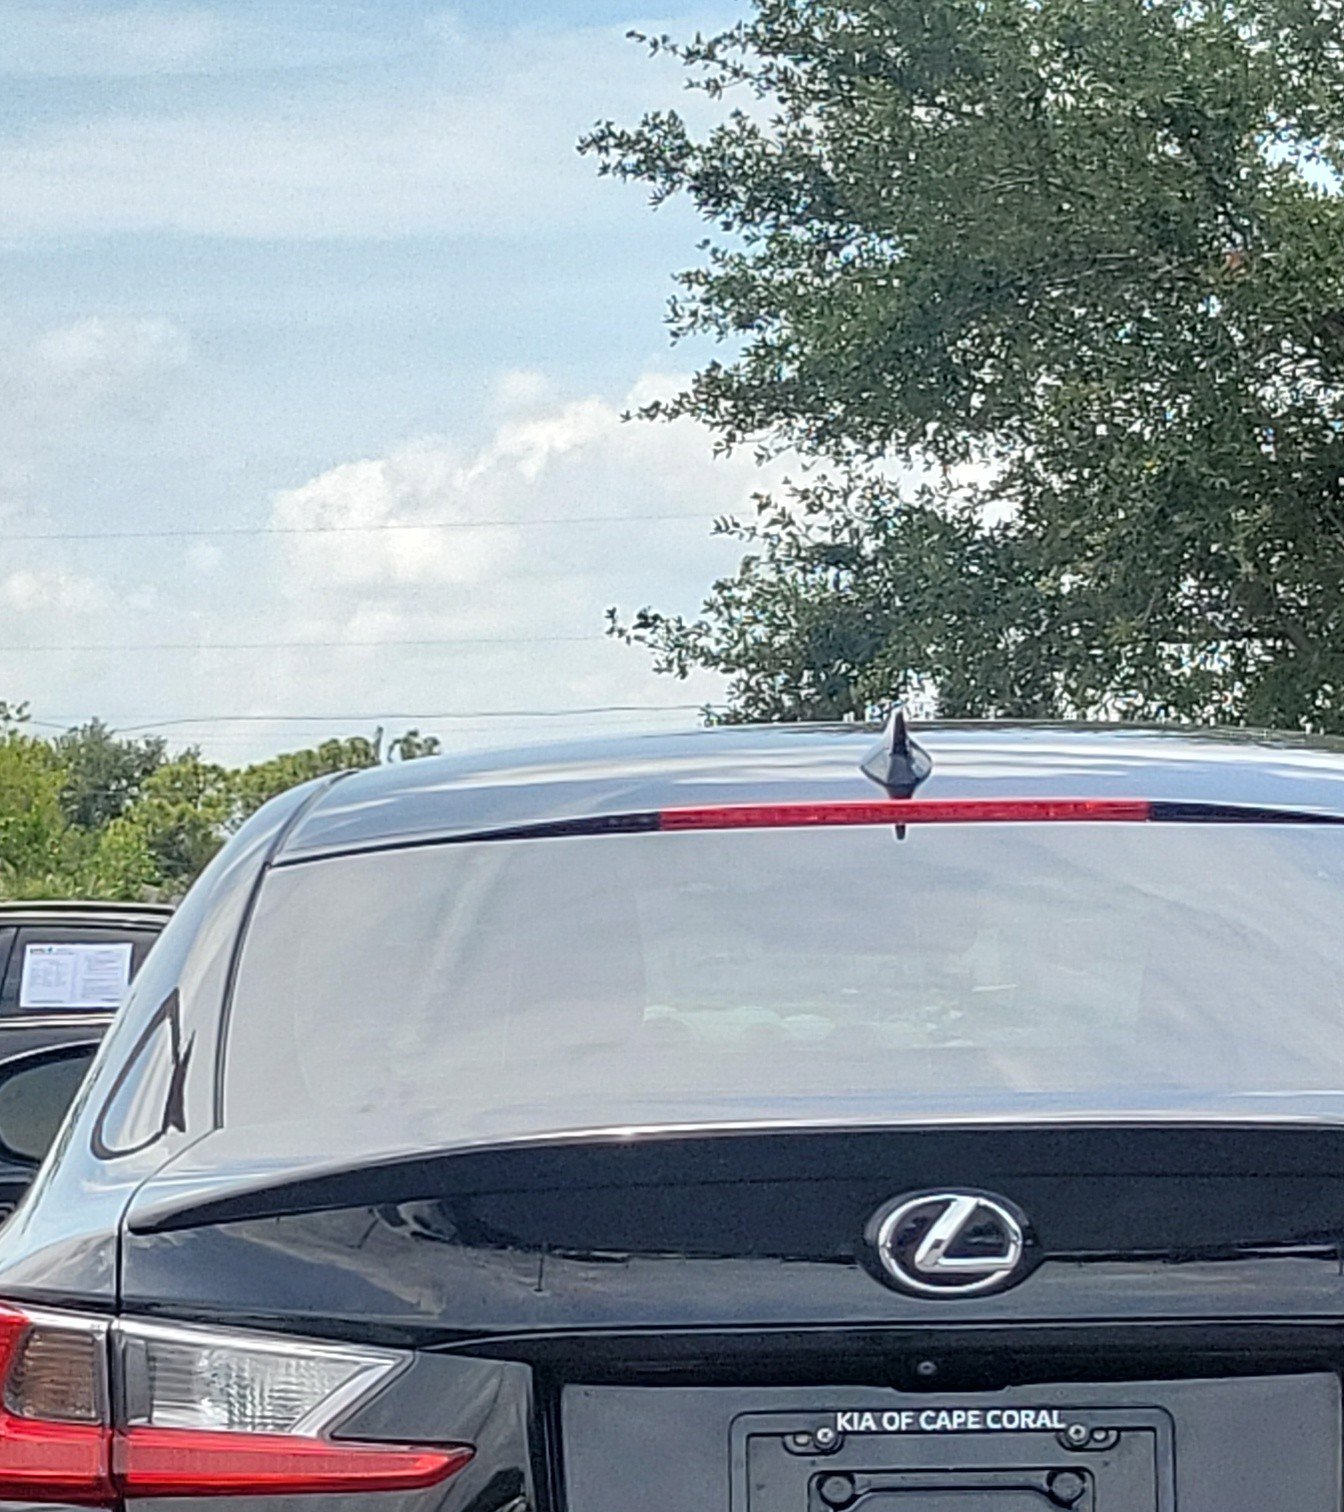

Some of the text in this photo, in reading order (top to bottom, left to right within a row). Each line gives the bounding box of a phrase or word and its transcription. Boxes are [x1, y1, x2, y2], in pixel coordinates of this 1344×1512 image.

[837, 1409, 1066, 1431] KIA OF CAPE CORAL
